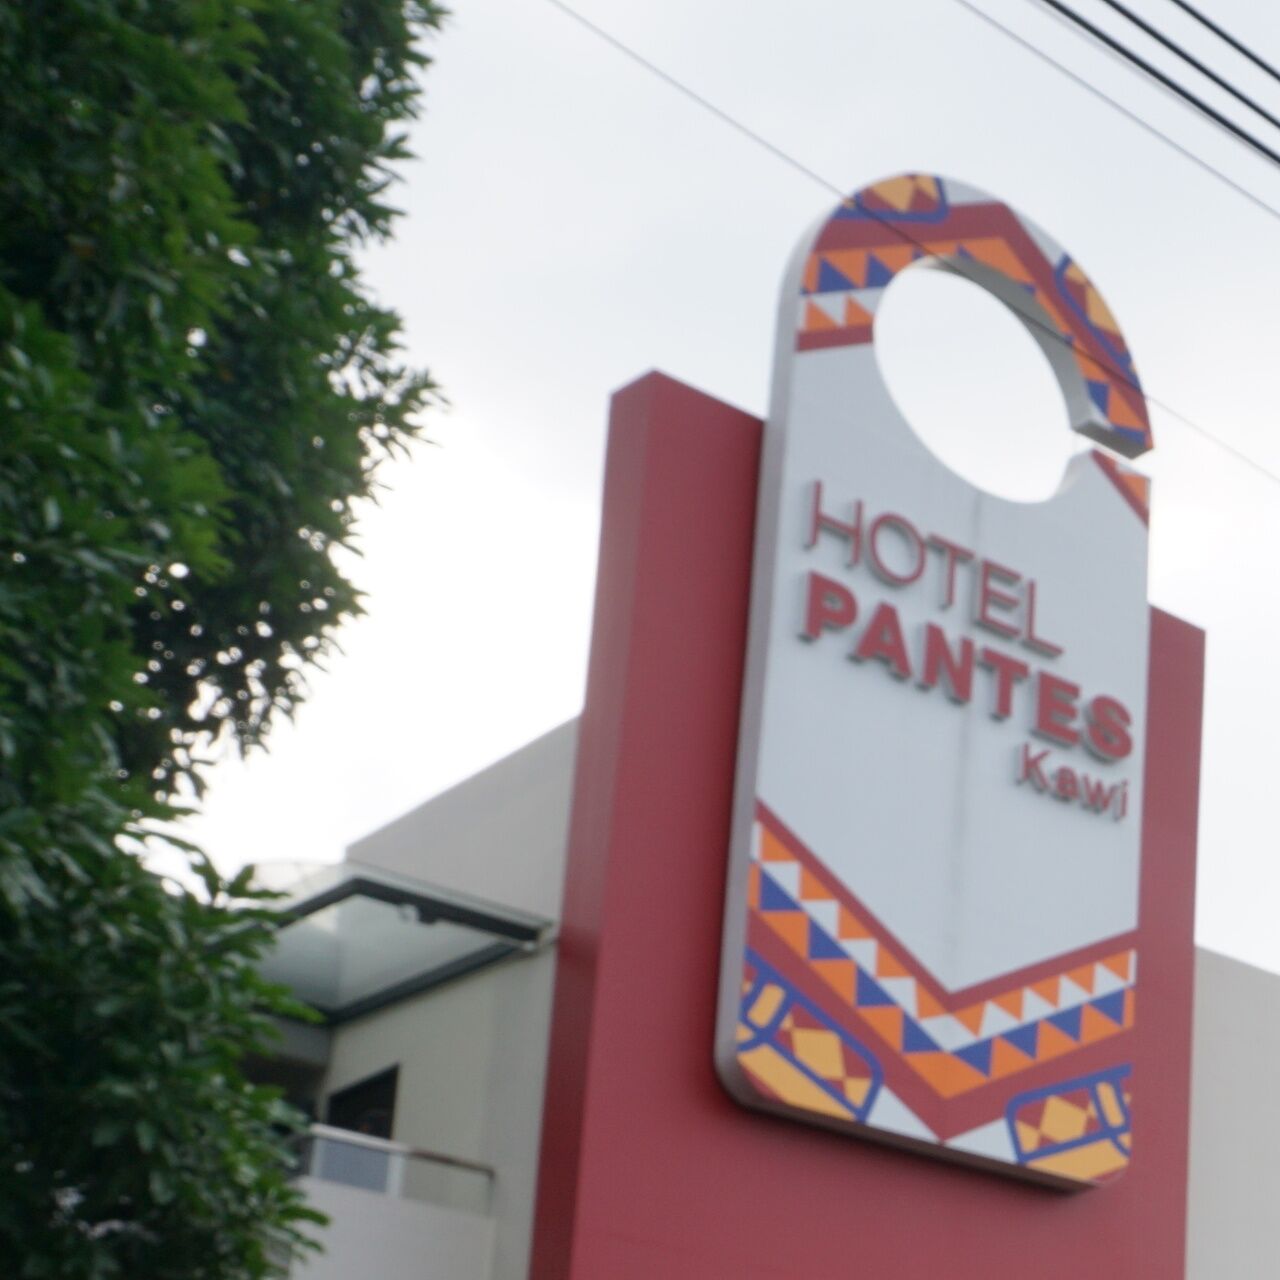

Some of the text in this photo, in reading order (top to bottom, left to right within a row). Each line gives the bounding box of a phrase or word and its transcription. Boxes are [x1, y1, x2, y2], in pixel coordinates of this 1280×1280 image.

[804, 479, 1064, 659] HOTEL
[800, 569, 1133, 763] PANTES
[1015, 742, 1130, 822] Kawi
